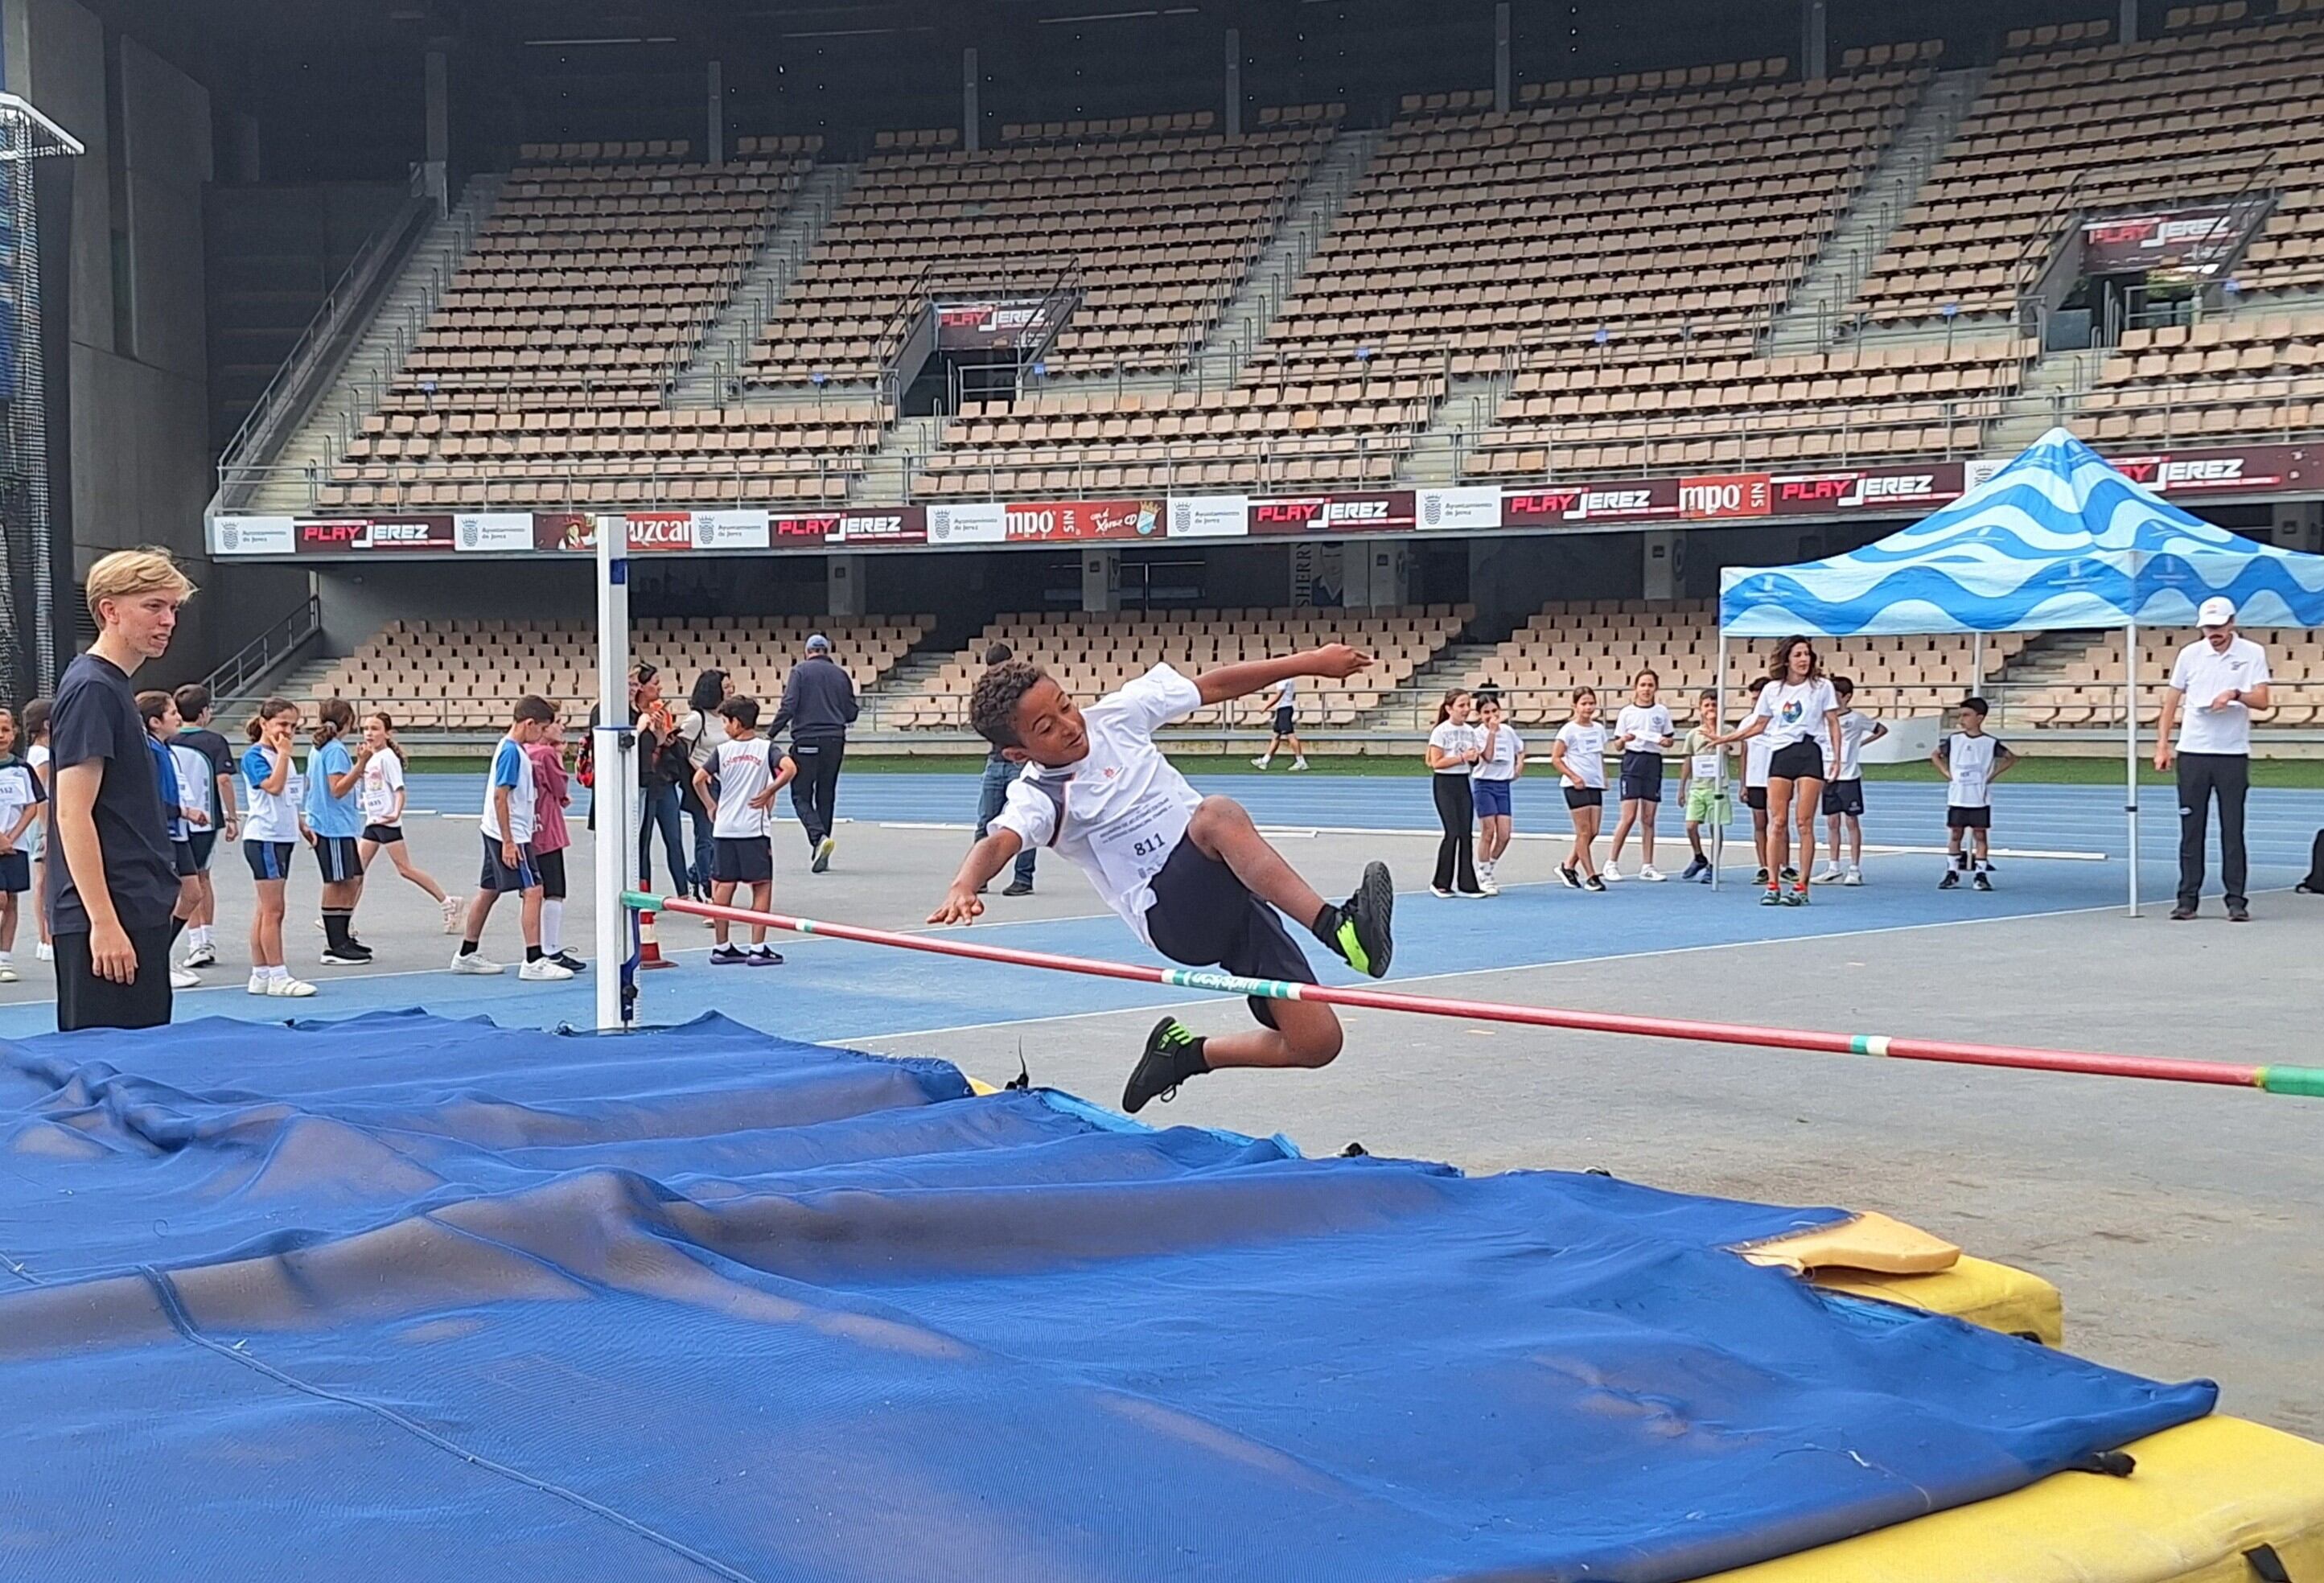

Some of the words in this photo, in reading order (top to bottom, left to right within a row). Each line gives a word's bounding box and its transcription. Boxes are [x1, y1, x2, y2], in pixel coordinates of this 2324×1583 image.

[1781, 480, 1852, 500] PLAY
[1511, 495, 1576, 513] PLAY
[1257, 505, 1317, 521] PLAY
[303, 526, 361, 541] PLAY
[778, 520, 834, 535] PLAY
[1134, 833, 1166, 856] 811
